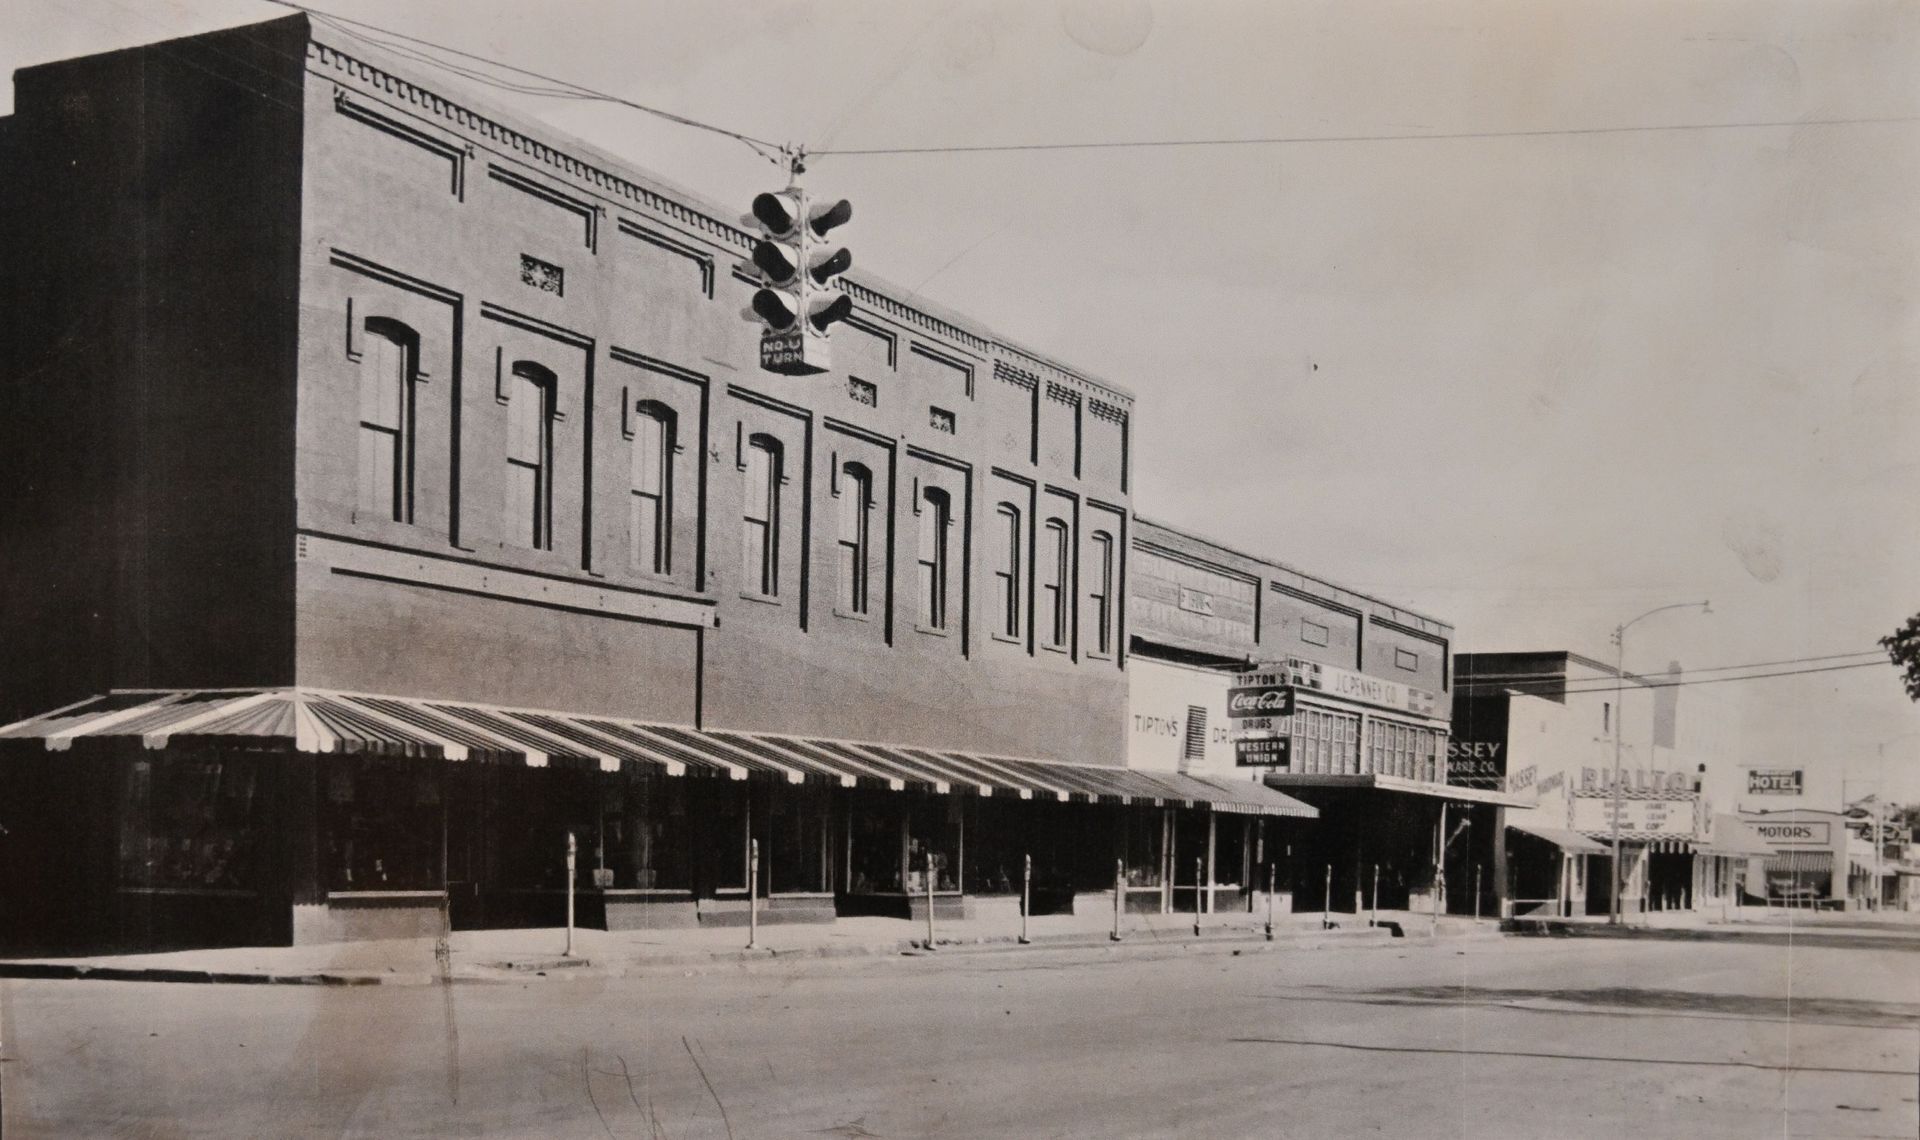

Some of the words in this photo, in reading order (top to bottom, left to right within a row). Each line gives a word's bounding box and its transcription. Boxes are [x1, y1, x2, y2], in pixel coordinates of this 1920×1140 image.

[762, 352, 802, 365] TURN
[1236, 673, 1286, 686] TIPTON'S
[1242, 718, 1273, 730] DRUGS
[1239, 742, 1286, 753] WESTERN
[1246, 753, 1279, 763] UNION
[1581, 766, 1687, 794] RIALTO
[1749, 776, 1801, 790] HOTEL
